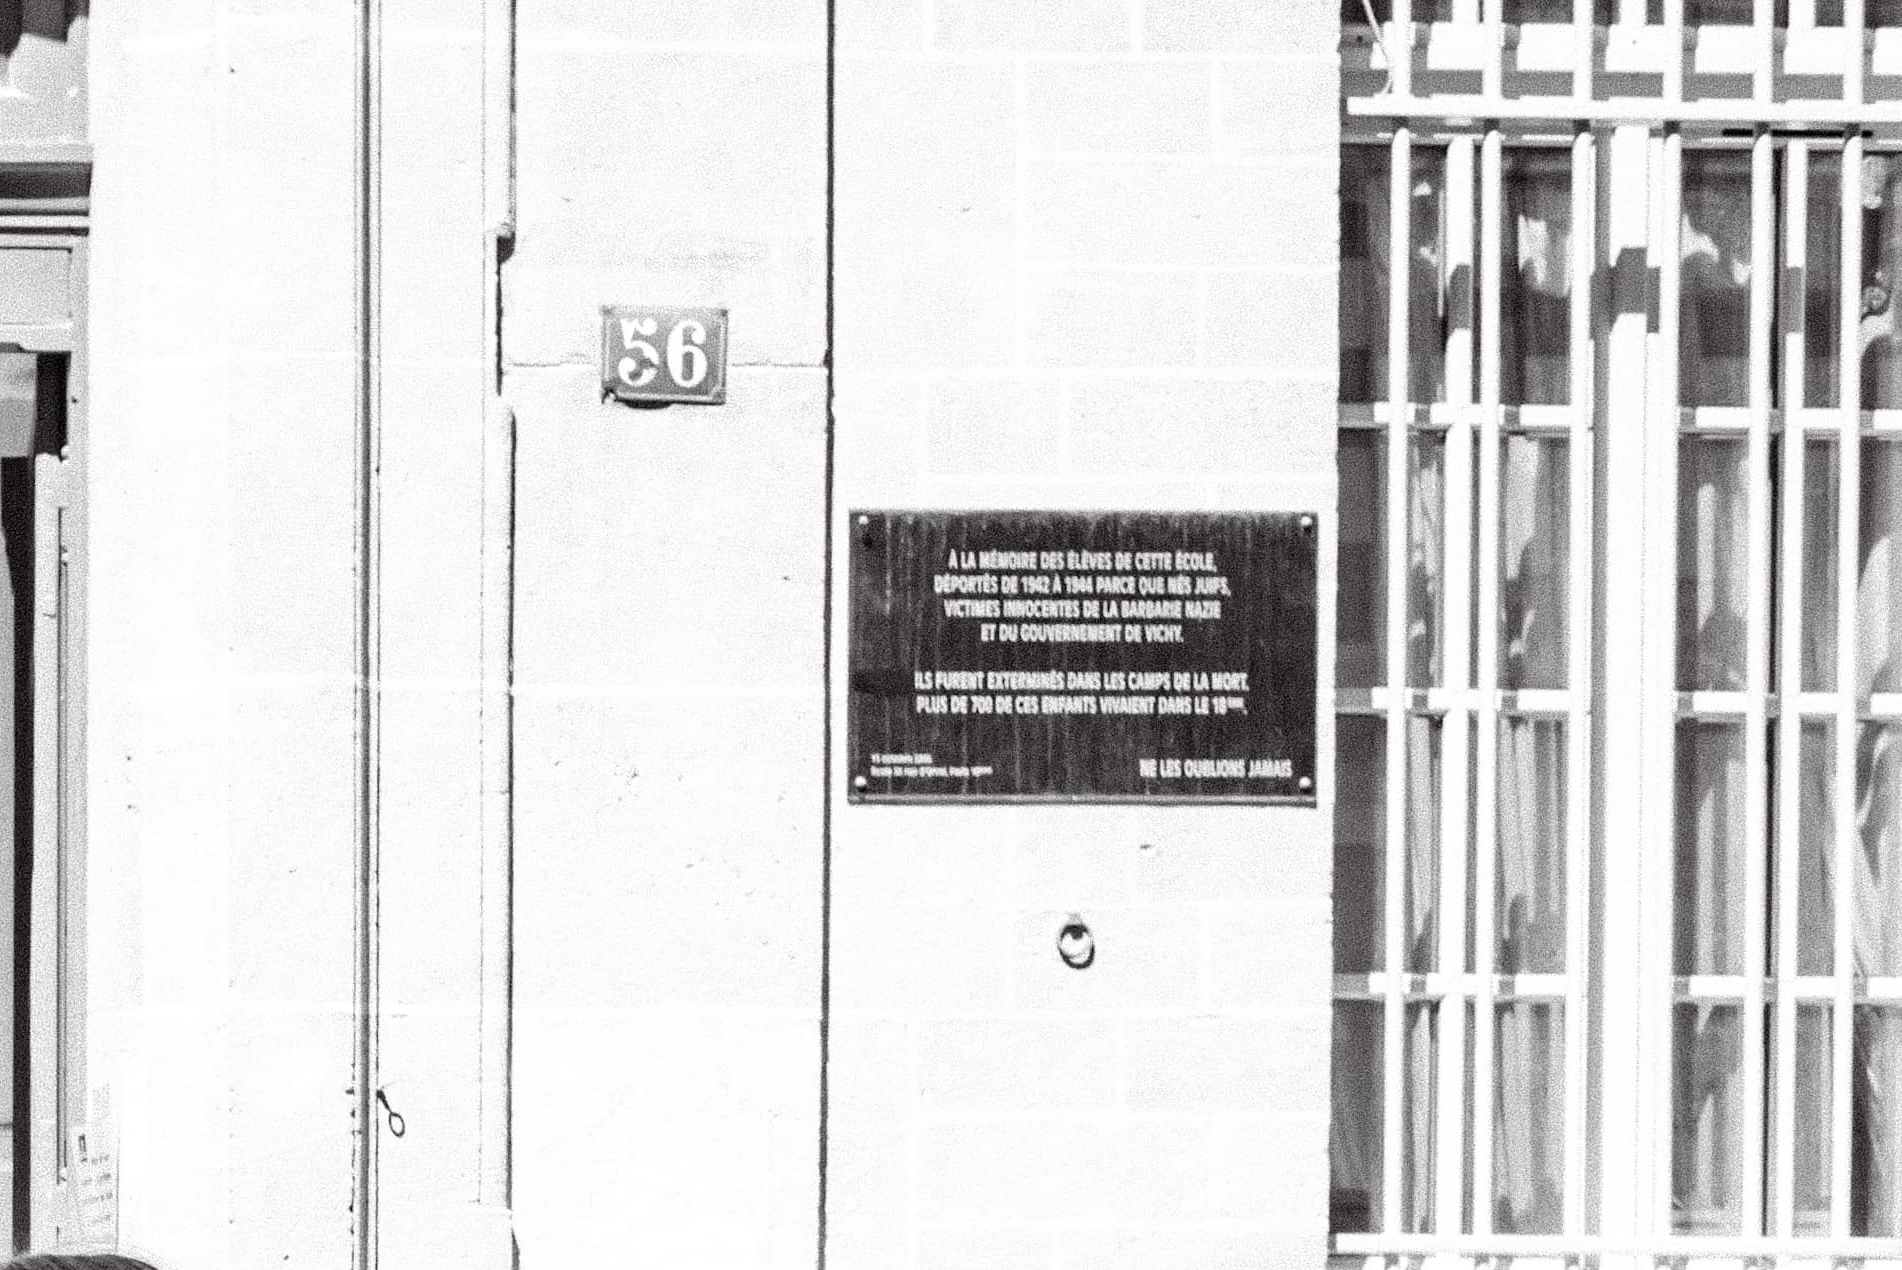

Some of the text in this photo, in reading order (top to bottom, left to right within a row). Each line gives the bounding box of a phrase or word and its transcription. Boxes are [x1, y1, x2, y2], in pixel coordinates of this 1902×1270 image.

[618, 318, 708, 388] 56
[961, 548, 976, 571] LA
[979, 548, 1037, 571] MÉMOIRE
[1041, 548, 1064, 571] DES
[1067, 548, 1111, 571] ÉLÈVES
[1115, 548, 1132, 571] DE
[1135, 548, 1172, 571] CETTE
[934, 573, 997, 595] DÉPORTÉS
[1001, 573, 1018, 595] DE
[1021, 573, 1050, 595] 1942
[1064, 573, 1093, 595] 1944
[1096, 573, 1135, 595] PARCE
[1138, 573, 1164, 595] QUE
[1168, 573, 1191, 595] NÉS
[944, 600, 1221, 618] VICTIMES INNOCENTES DE LA BARBARIE NAZIE
[981, 623, 995, 642] ET
[999, 623, 1018, 642] DU
[1020, 623, 1122, 642] GOUVERNEMENT
[1125, 623, 1141, 642] DE
[914, 671, 933, 690] ILS
[936, 671, 984, 690] FURENT
[987, 671, 1065, 690] EXTERMINÉS
[1067, 671, 1100, 690] DANS
[1103, 671, 1125, 690] LES
[1129, 671, 1170, 690] CAMPS
[1174, 671, 1190, 690] DE
[1193, 671, 1209, 690] LA
[917, 695, 947, 714] PLUS
[951, 695, 968, 714] DE
[971, 695, 993, 714] 700
[996, 695, 1012, 714] DE
[1015, 695, 1038, 714] CES
[1041, 695, 1097, 714] ENFANTS
[1100, 695, 1155, 714] VIVAIENT
[1158, 695, 1192, 714] DANS
[1194, 695, 1208, 714] LE
[1140, 758, 1293, 778] NE LES OUBLIONS JAMAIS
